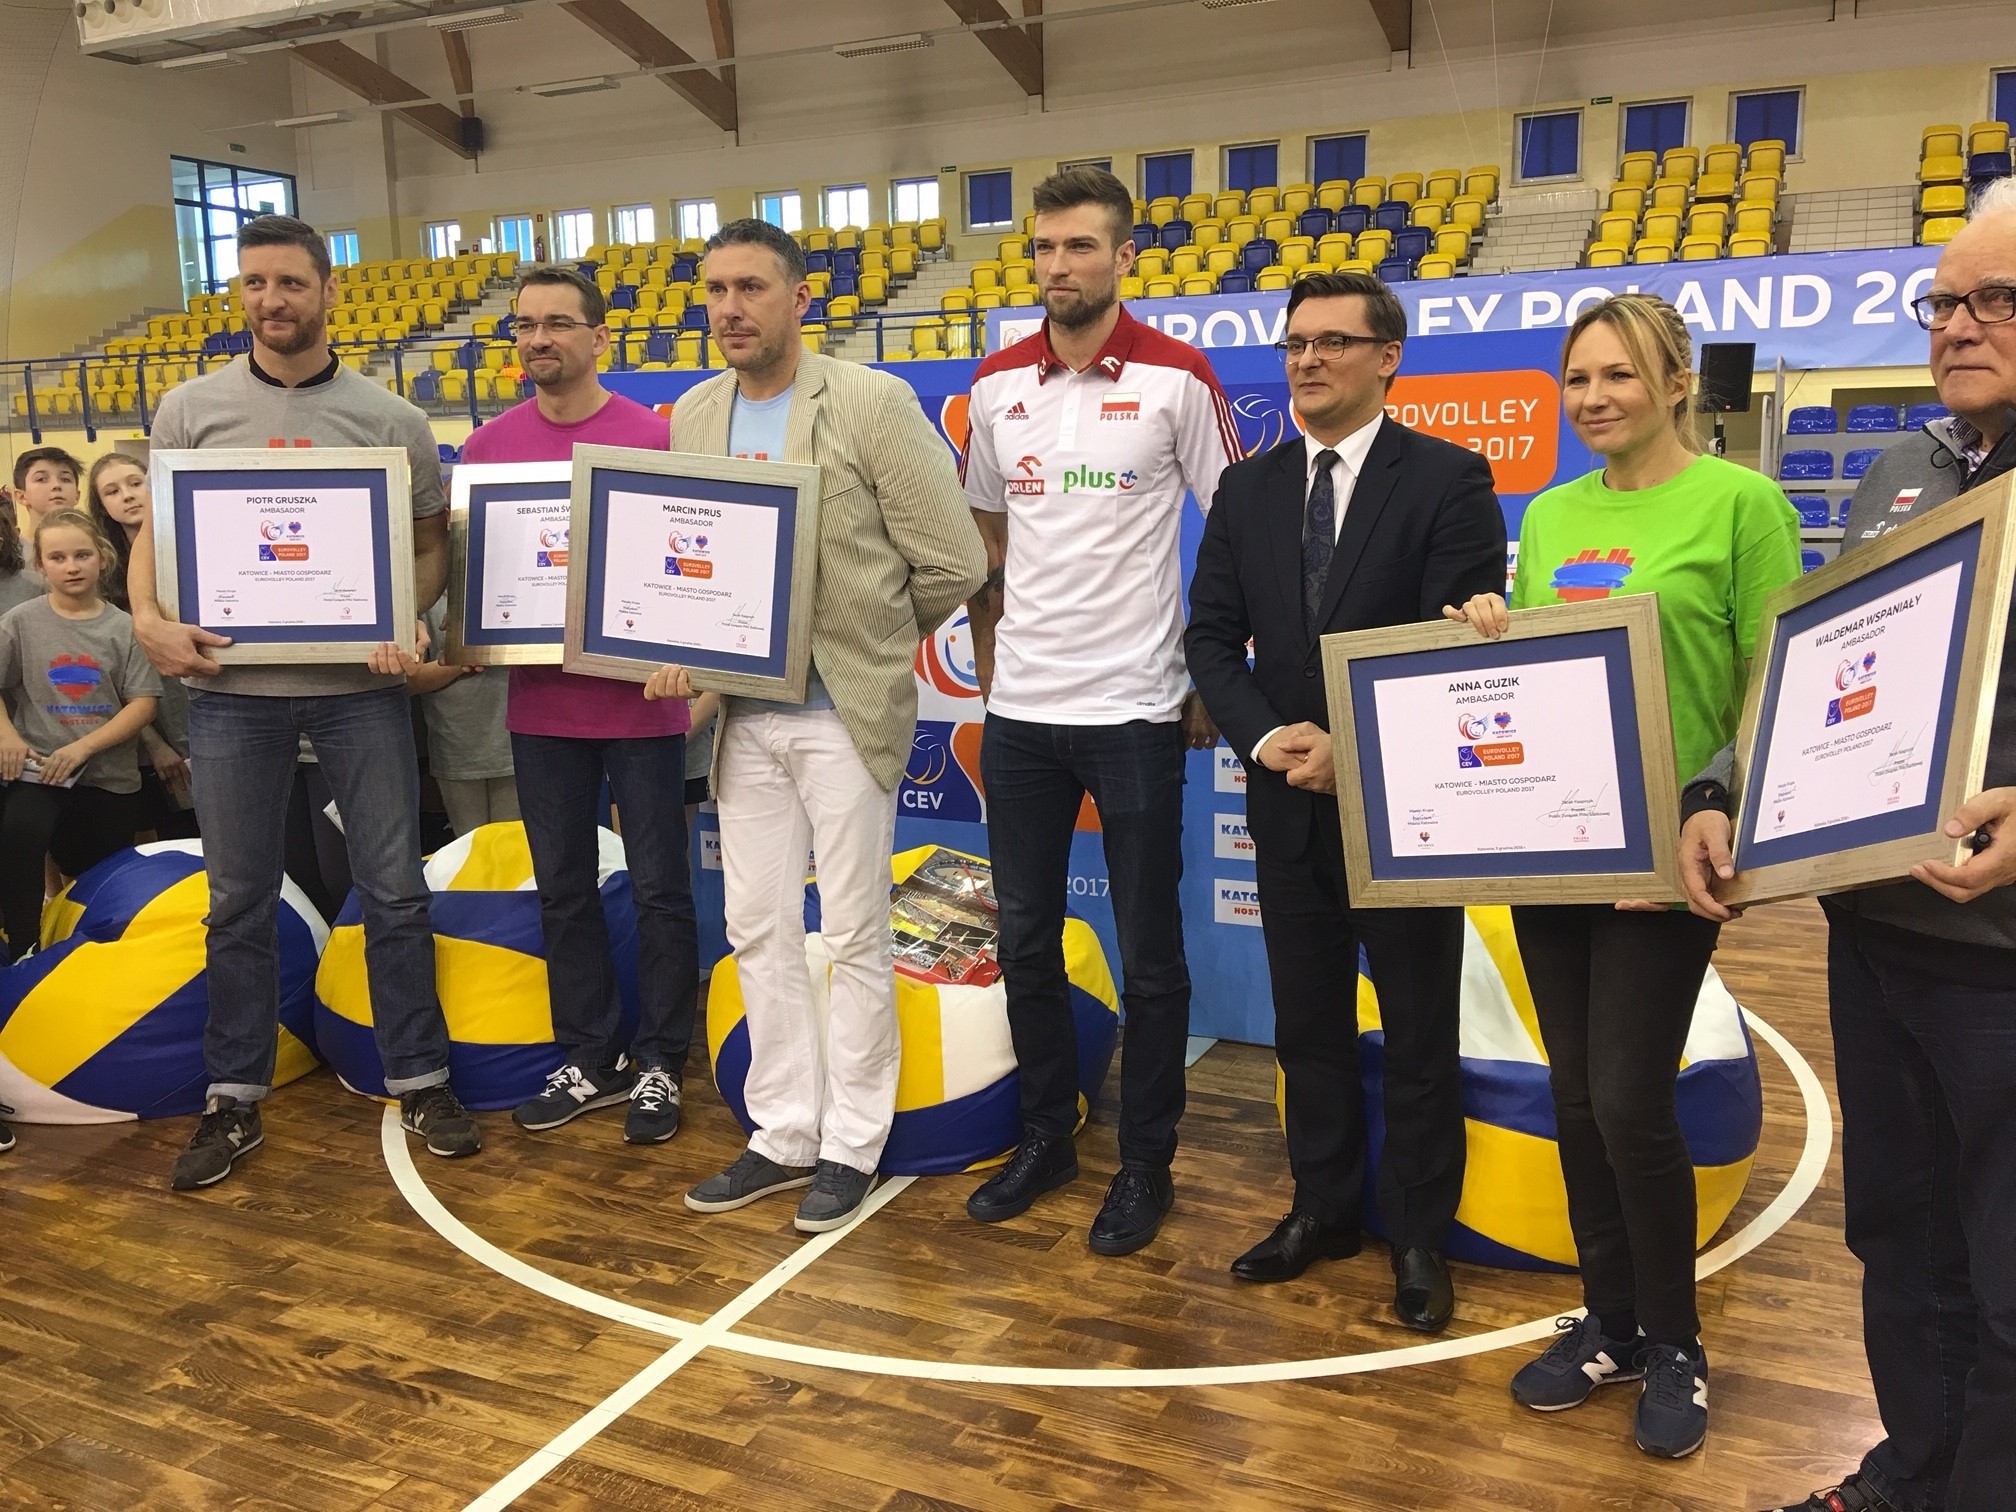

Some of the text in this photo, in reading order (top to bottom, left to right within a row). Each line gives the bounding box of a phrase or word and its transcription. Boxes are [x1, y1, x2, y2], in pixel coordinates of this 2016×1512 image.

[1004, 412, 1029, 421] adidas
[1099, 412, 1139, 421] POLSKA
[1063, 464, 1116, 493] plus
[1008, 481, 1042, 494] ORLEN
[246, 496, 318, 505] PIOTR GRUSZKA
[516, 506, 560, 515] SEBASTIAN
[662, 504, 722, 518] MARCIN PRUS
[1889, 504, 1912, 513] POLSKA
[669, 516, 714, 527] AMBASADOR
[643, 582, 672, 591] KATOWICE
[676, 586, 698, 594] MIASTO
[698, 588, 733, 598] GOSPODARZ
[658, 591, 687, 599] EUROVOLLEY
[1815, 593, 1922, 648] WALDEMAR WSPANIAŁY
[1840, 625, 1886, 651] AMBASADOR
[1448, 676, 1520, 693] ANNA GUZIK
[1455, 692, 1515, 705] AMBASADOR
[1801, 741, 1830, 756] KATOWICE
[1833, 734, 1855, 747] MIASTO
[1856, 722, 1892, 740] GOSPODARZ
[1482, 746, 1520, 754] EUROVOLLEY
[1434, 780, 1473, 790] KATOWICE
[1479, 778, 1508, 787] MIASTO
[1508, 775, 1557, 785] GOSPODARZ
[1456, 788, 1494, 796] EUROVOLLEY
[902, 789, 944, 810] CEV
[1234, 842, 1256, 850] HOS
[1234, 907, 1260, 916] HOST
